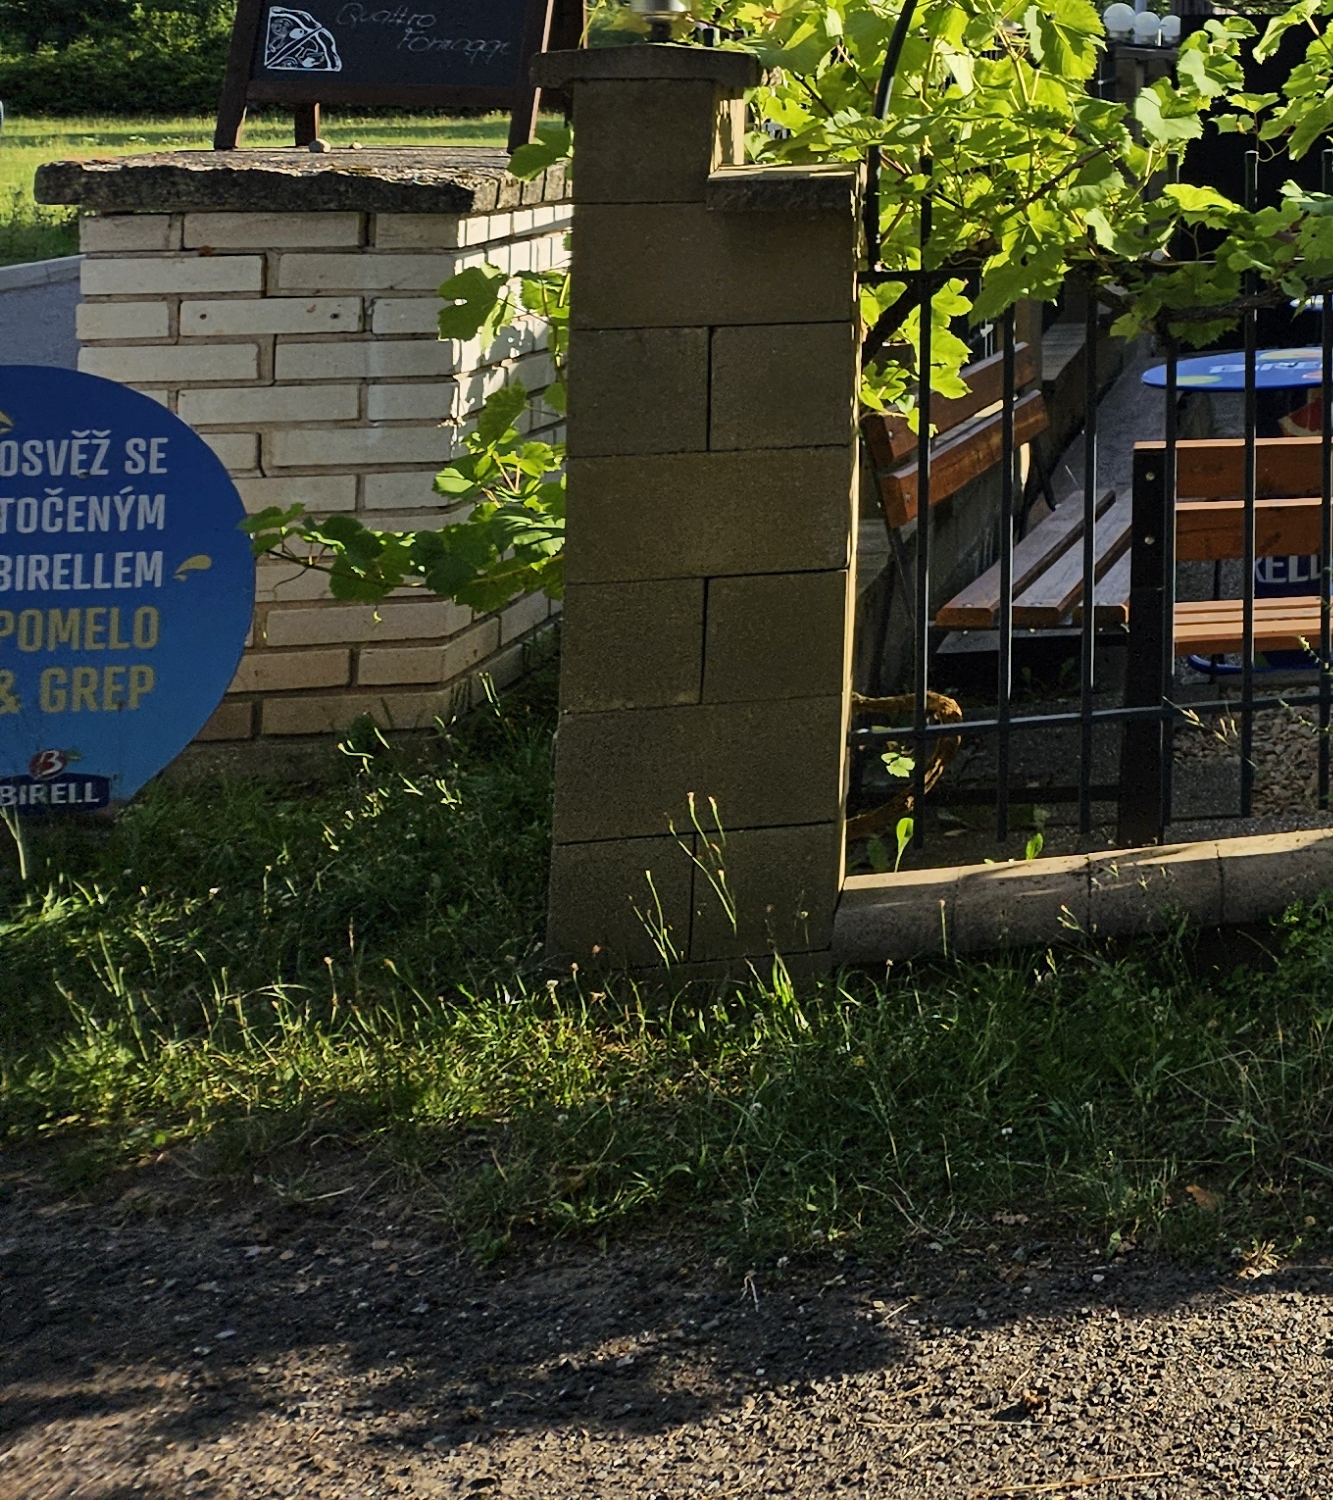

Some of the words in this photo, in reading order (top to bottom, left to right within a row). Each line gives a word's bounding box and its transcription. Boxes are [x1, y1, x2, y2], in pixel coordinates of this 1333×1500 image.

[336, 2, 437, 29] Quattro
[0, 430, 111, 477] OSVĚŽ
[124, 437, 169, 475] SE
[0, 485, 166, 534] TOČENÝM
[0, 551, 164, 592] BIRELLEM
[0, 605, 160, 653] POMELO
[38, 664, 156, 714] GREP
[0, 782, 101, 807] BIRELL
